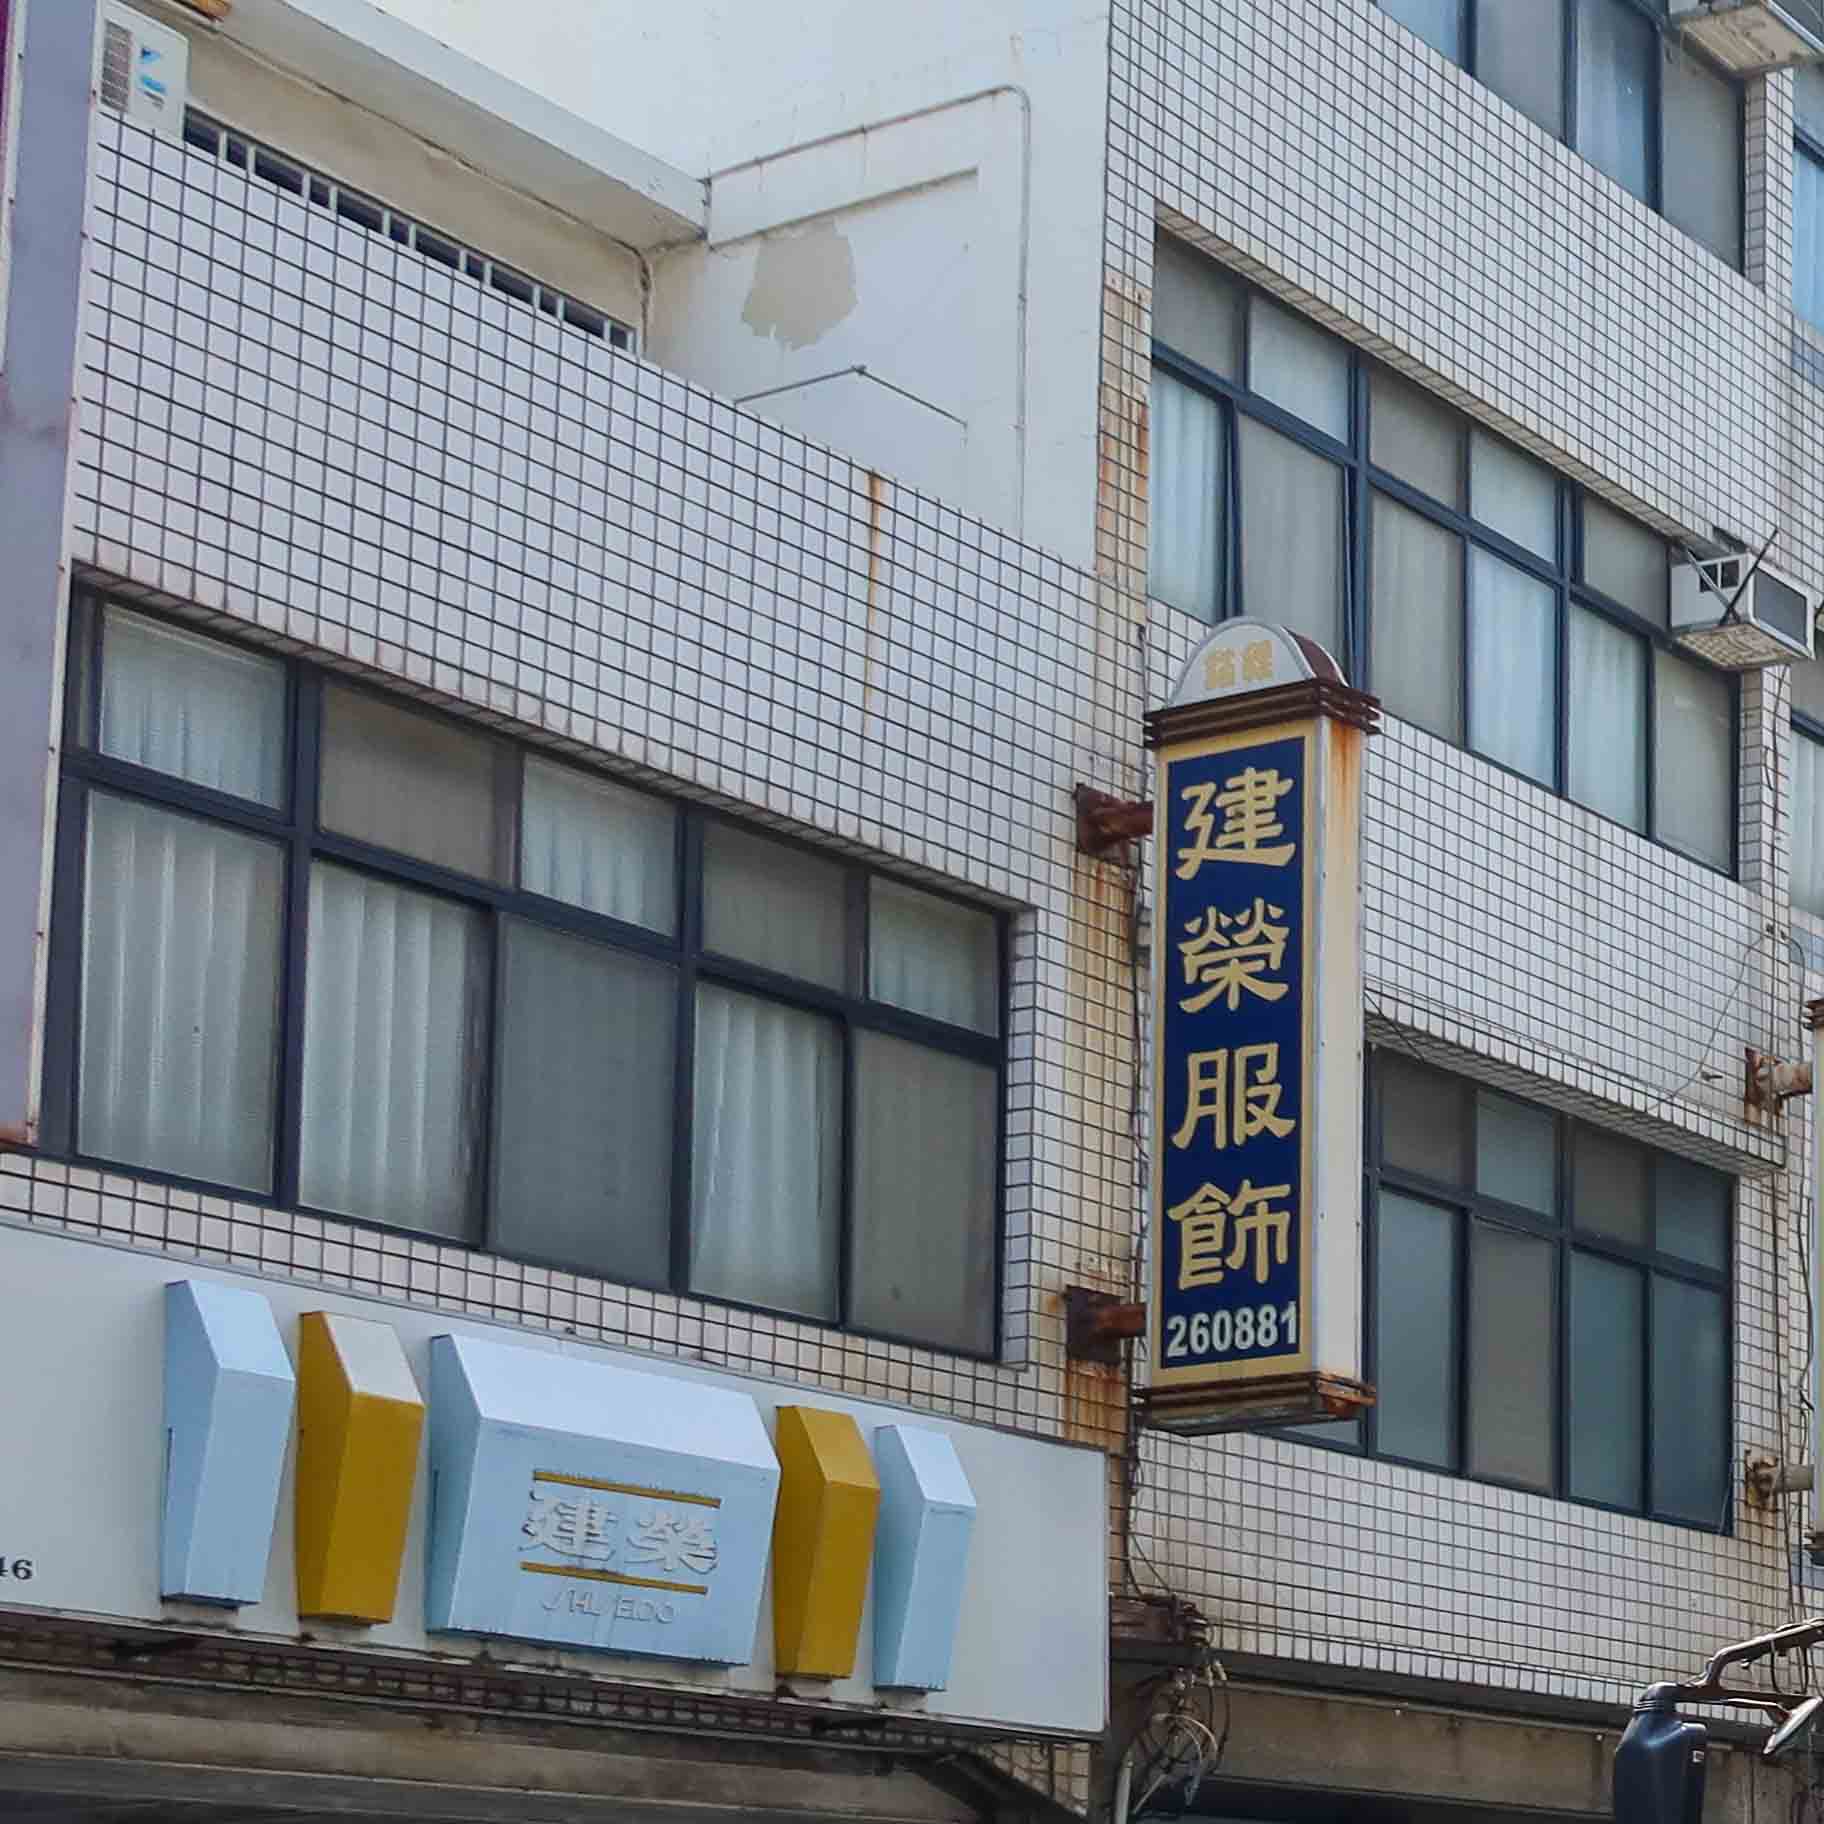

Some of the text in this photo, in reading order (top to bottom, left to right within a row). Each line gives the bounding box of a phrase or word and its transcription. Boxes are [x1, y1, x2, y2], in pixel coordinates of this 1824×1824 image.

[1166, 767, 1297, 1292] 建榮服飾
[1165, 1300, 1300, 1361] 260881
